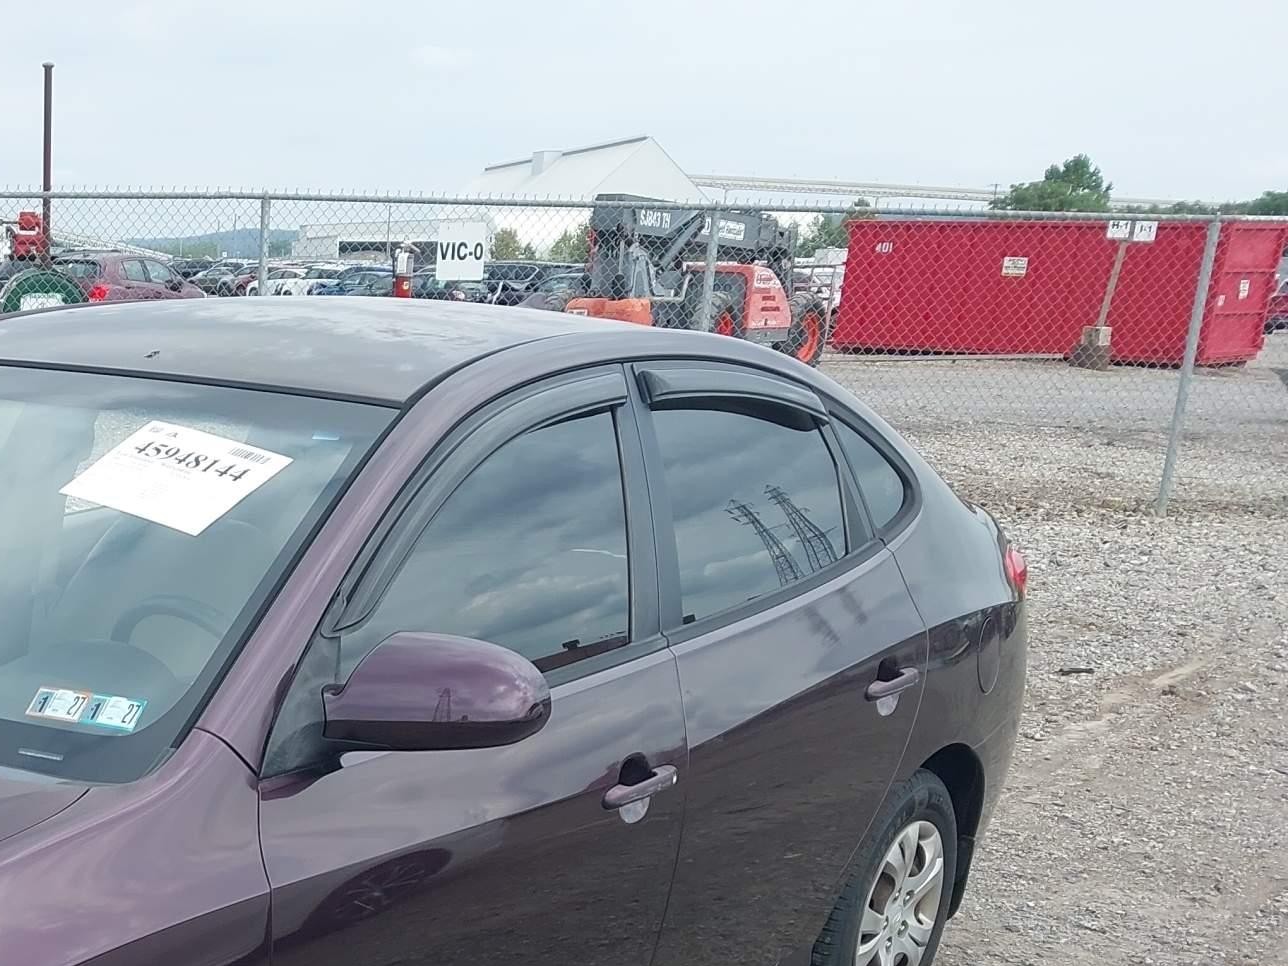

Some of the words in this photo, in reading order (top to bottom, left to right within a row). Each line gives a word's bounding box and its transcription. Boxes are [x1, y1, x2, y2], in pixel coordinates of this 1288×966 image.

[1111, 221, 1130, 229] H-1
[875, 241, 894, 253] 401
[134, 440, 252, 482] 45948144
[66, 695, 87, 718] 27
[121, 703, 142, 724] 27
